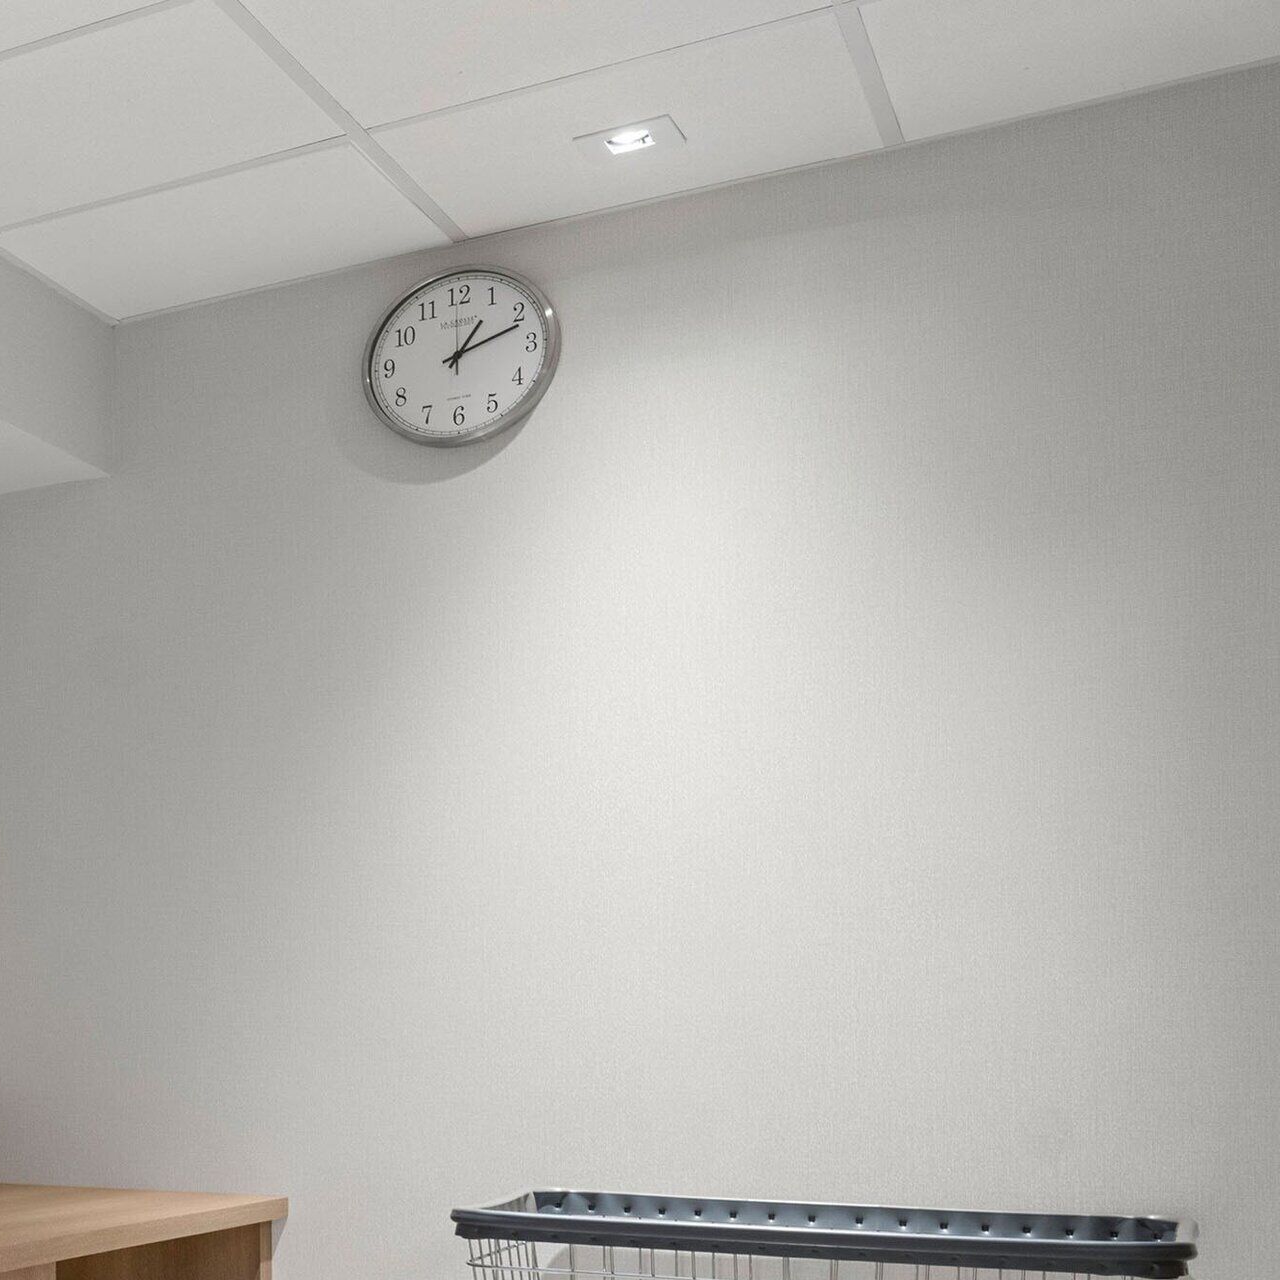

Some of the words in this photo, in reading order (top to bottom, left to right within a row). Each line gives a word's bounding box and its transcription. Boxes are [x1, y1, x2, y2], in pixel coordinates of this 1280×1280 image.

[447, 285, 471, 307] 12
[488, 287, 497, 306] 1
[417, 301, 438, 321] 11
[513, 302, 525, 323] 2
[395, 326, 416, 348] 10
[525, 333, 537, 352] 3
[384, 360, 395, 378] 9
[512, 367, 524, 385] 4
[395, 387, 407, 406] 8
[486, 393, 498, 413] 5
[421, 405, 432, 424] 7
[453, 406, 465, 426] 6
